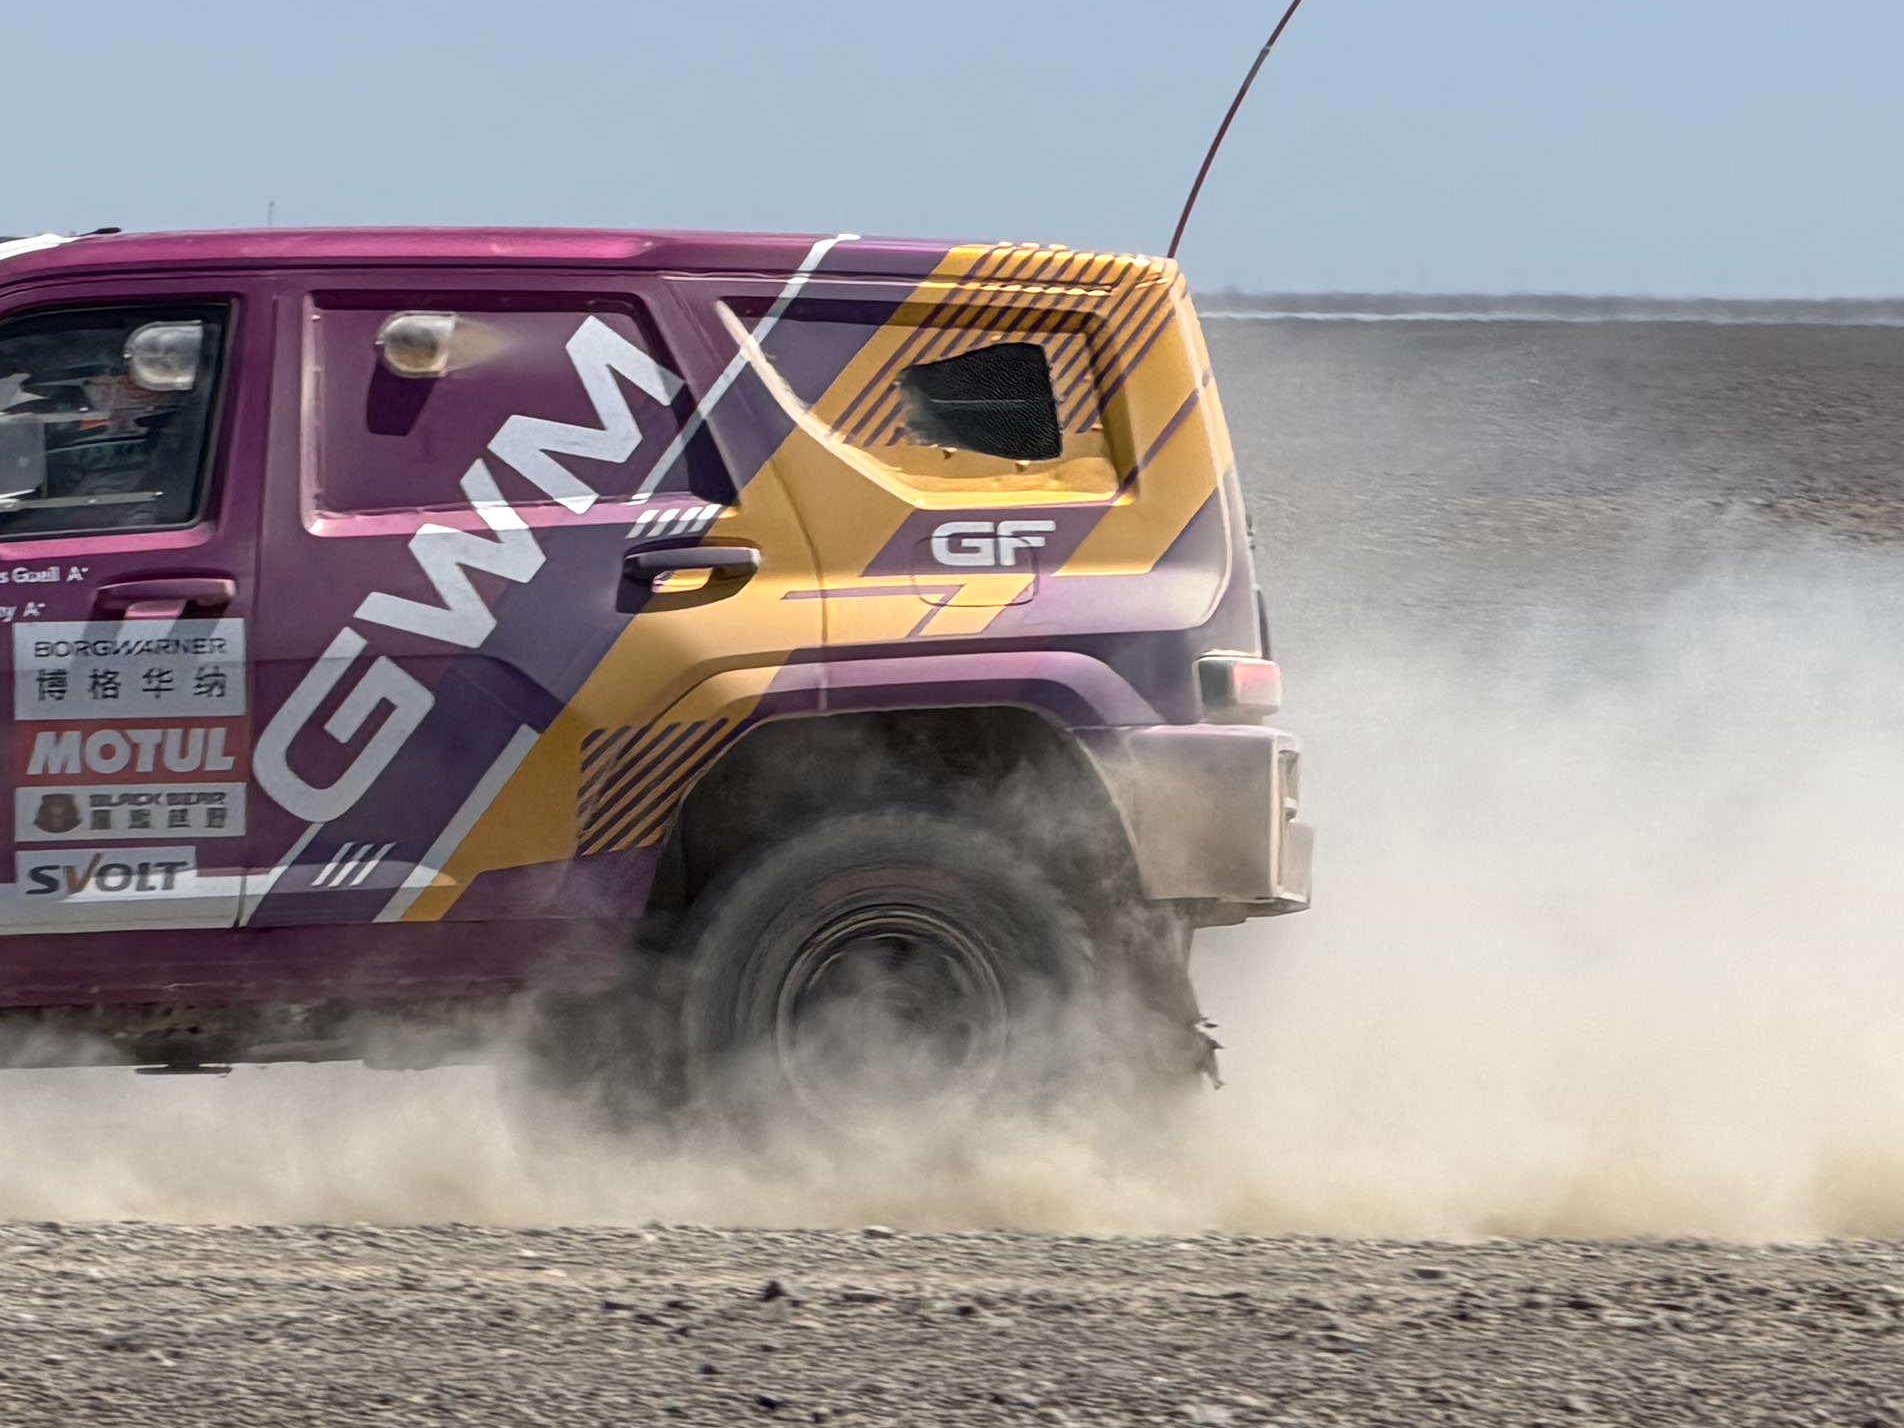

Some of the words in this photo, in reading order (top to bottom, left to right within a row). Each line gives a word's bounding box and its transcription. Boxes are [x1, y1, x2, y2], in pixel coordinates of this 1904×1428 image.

[931, 520, 1056, 566] GF
[253, 315, 686, 823] GWM
[34, 637, 227, 658] BORGWARNER
[35, 665, 227, 701] 博格华纳
[26, 727, 235, 775] MOTUL
[26, 852, 189, 895] SVOLT
